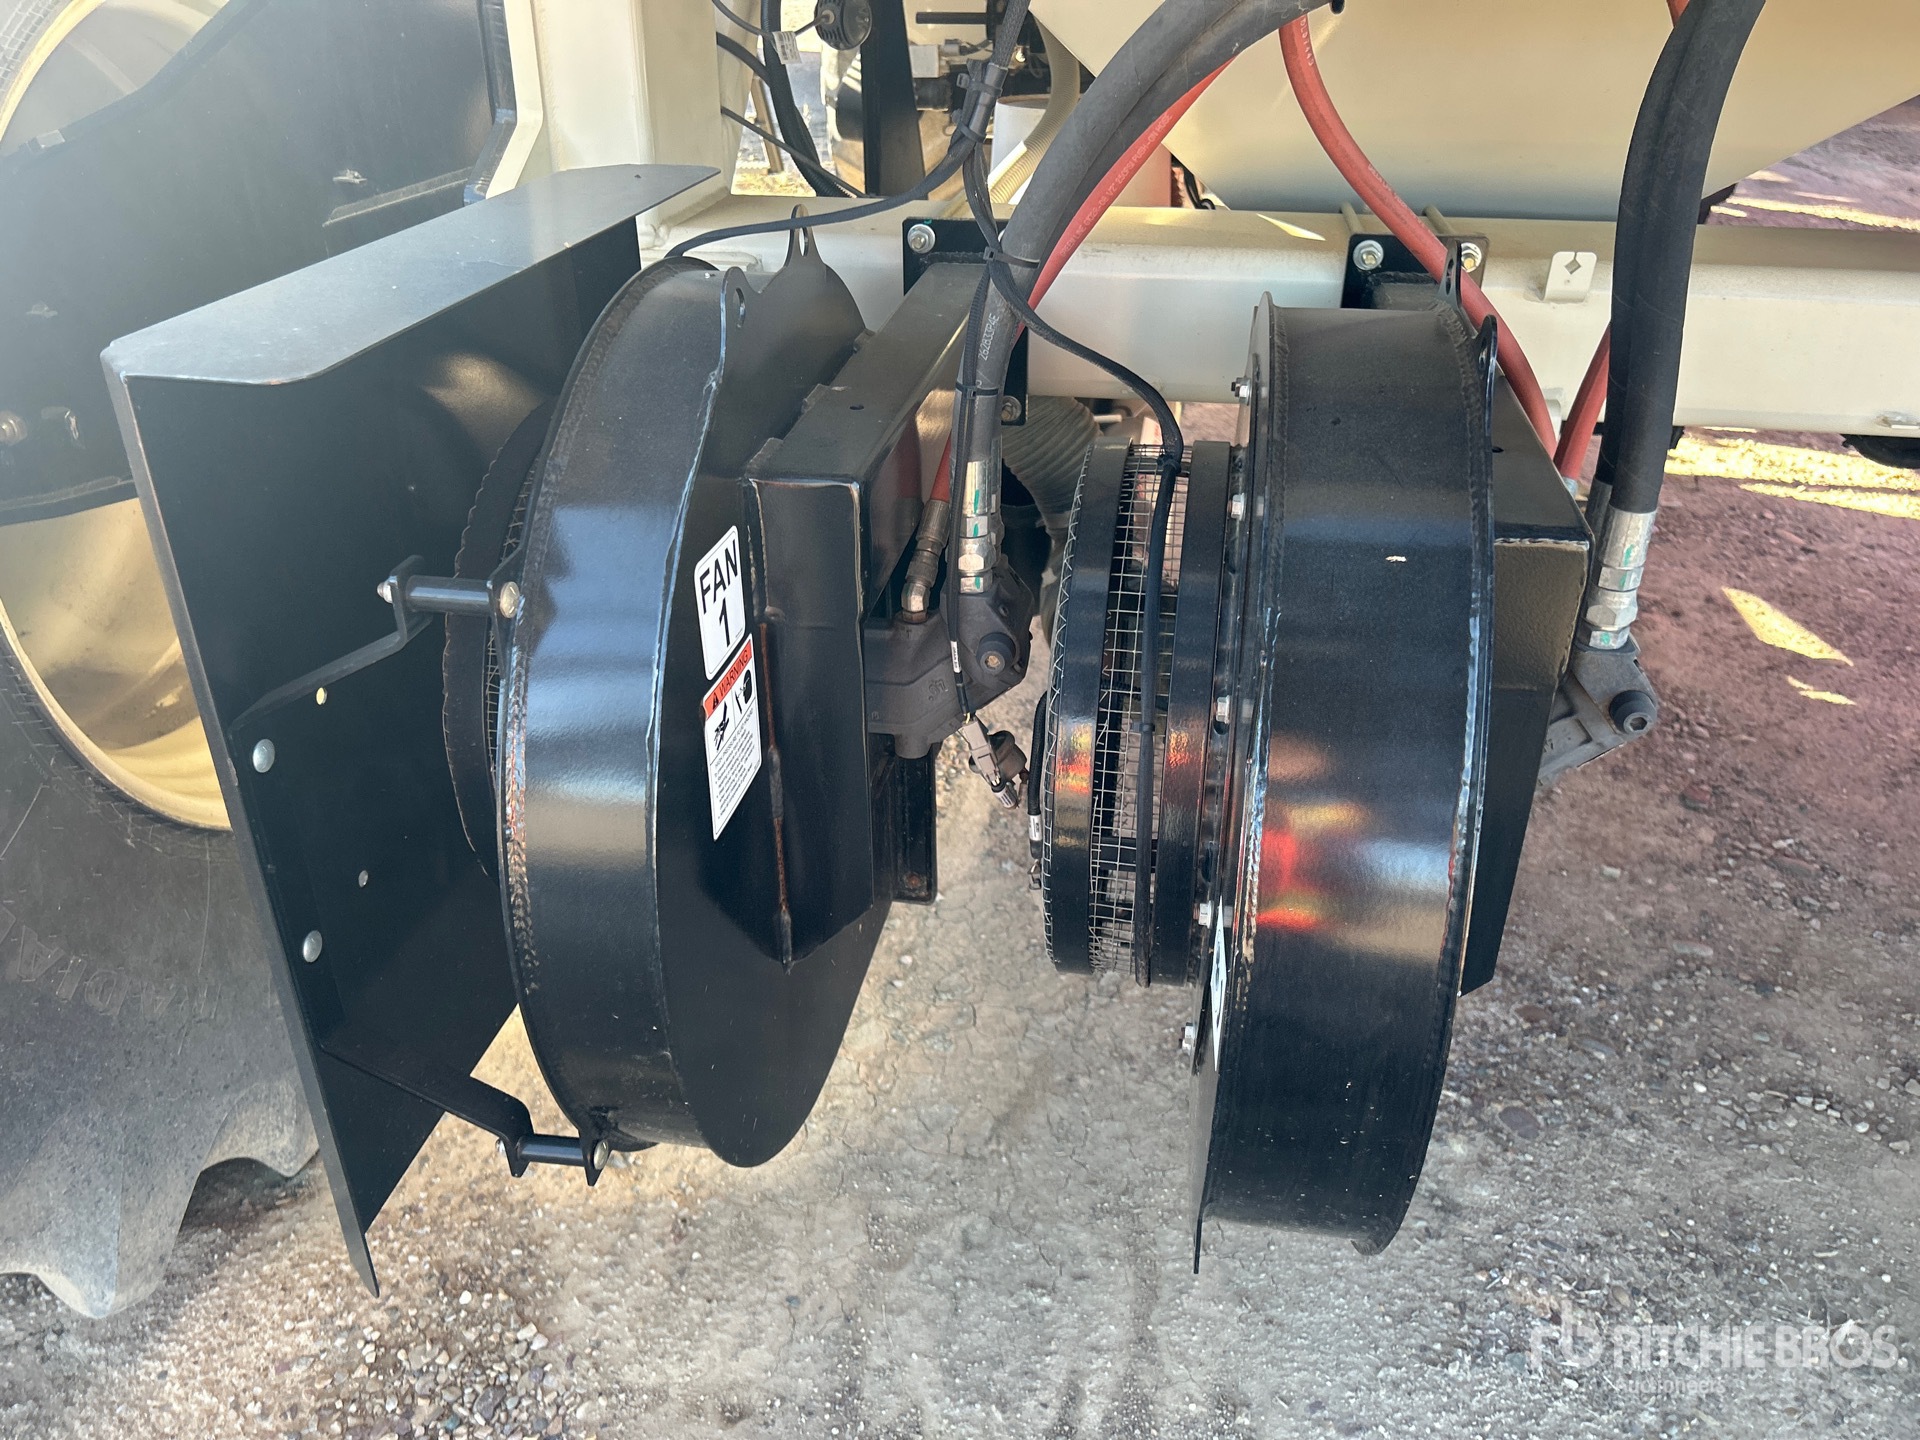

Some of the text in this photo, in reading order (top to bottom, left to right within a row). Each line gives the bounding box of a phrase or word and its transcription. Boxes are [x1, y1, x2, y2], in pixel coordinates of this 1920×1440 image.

[700, 539, 738, 614] FAN
[719, 597, 730, 647] 1
[719, 649, 749, 698] WARNING
